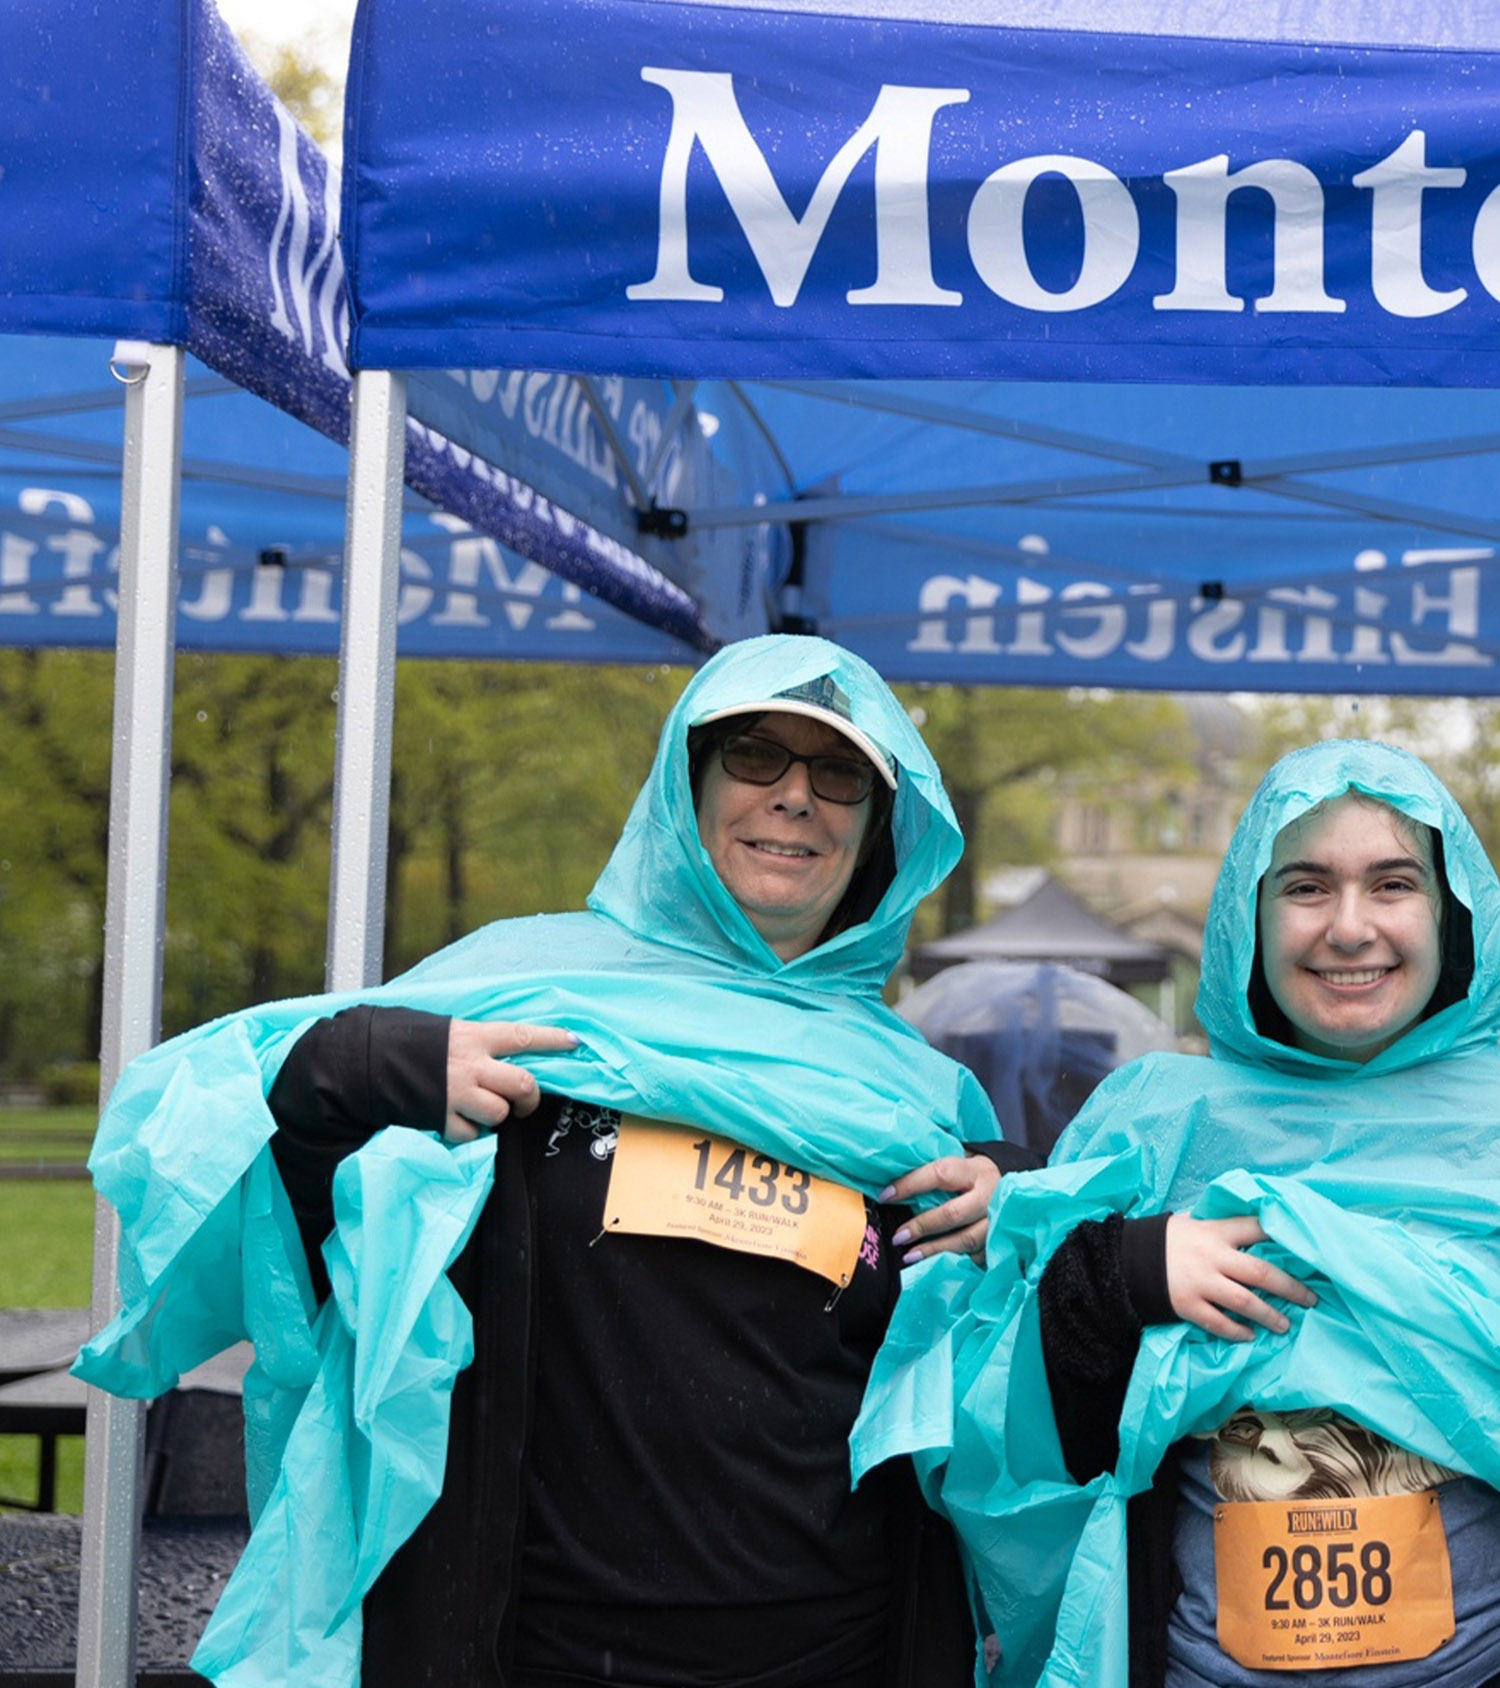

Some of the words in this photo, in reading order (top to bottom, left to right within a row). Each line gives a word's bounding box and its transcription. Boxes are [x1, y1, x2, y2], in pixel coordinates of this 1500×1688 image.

[693, 1138, 812, 1216] 1433
[708, 1199, 723, 1211] AM
[734, 1207, 746, 1218] 3K
[748, 1210, 800, 1229] RUN/WALK
[709, 1213, 730, 1226] April
[749, 1222, 774, 1236] 2023
[1292, 1512, 1317, 1532] RUN
[1322, 1510, 1353, 1531] WILD
[1262, 1541, 1392, 1610] 2858
[1271, 1619, 1290, 1630] 9:30
[1292, 1618, 1307, 1628] AM
[1318, 1617, 1331, 1628] 3K
[1333, 1613, 1386, 1627] RUN/WALK
[1295, 1633, 1317, 1645] April
[1319, 1633, 1335, 1644] 29,
[1337, 1630, 1361, 1642] 2023
